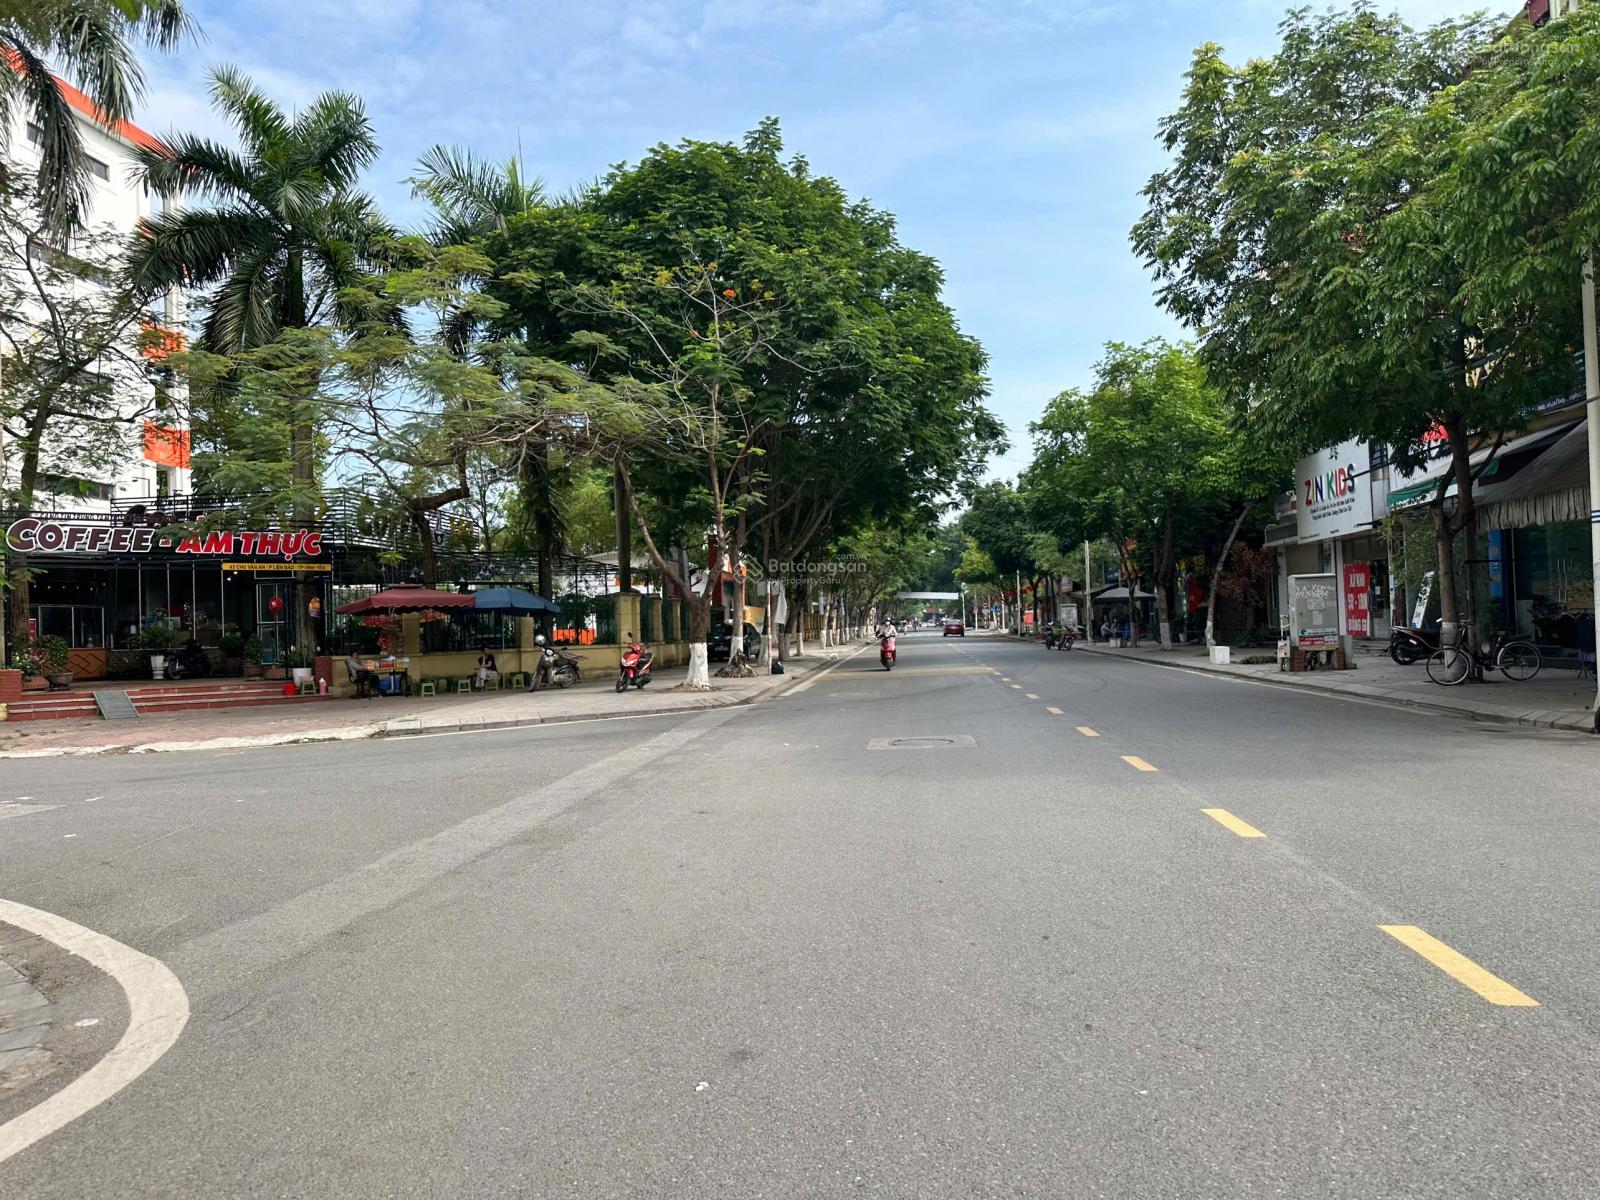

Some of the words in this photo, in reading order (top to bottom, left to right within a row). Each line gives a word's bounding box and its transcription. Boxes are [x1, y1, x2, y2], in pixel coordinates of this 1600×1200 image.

[1304, 475, 1324, 506] ZIN
[1327, 463, 1355, 501] KIDS
[6, 518, 156, 553] COFFEE
[240, 528, 322, 561] THỰC
